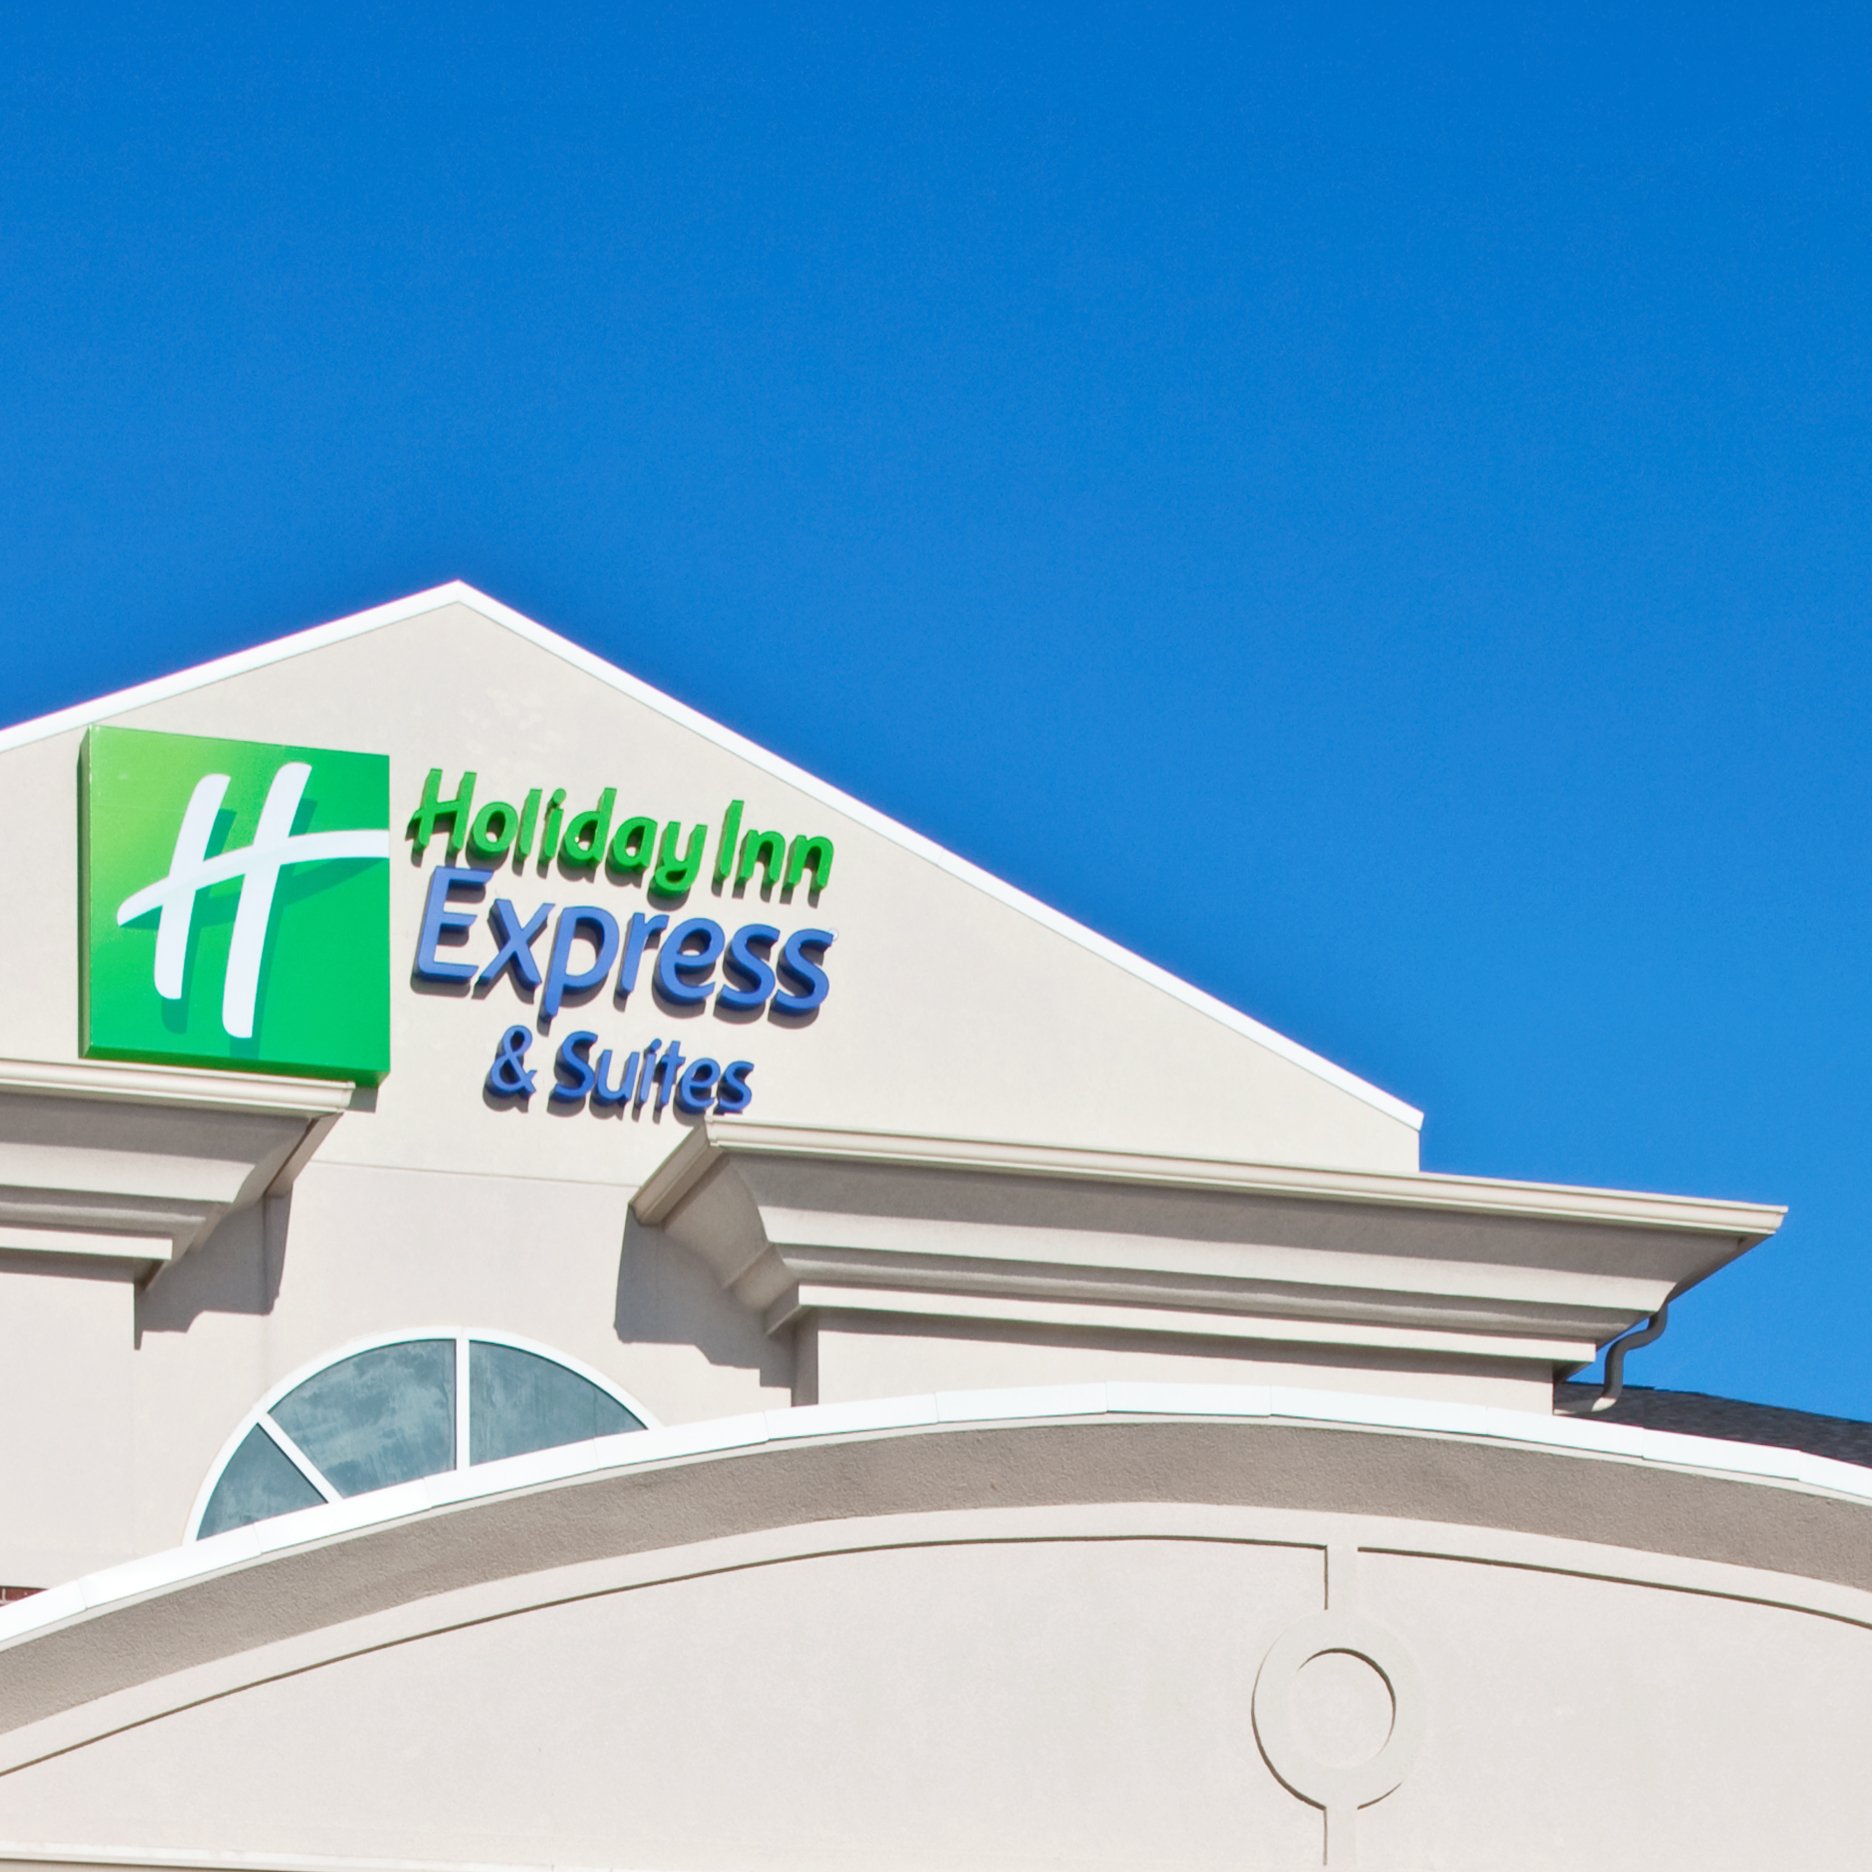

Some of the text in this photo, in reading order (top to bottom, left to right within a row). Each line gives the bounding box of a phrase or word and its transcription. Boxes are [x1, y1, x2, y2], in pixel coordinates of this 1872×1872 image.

[407, 768, 835, 894] Holiday Inn
[415, 865, 835, 1020] Express
[487, 1025, 755, 1114] & Suites
